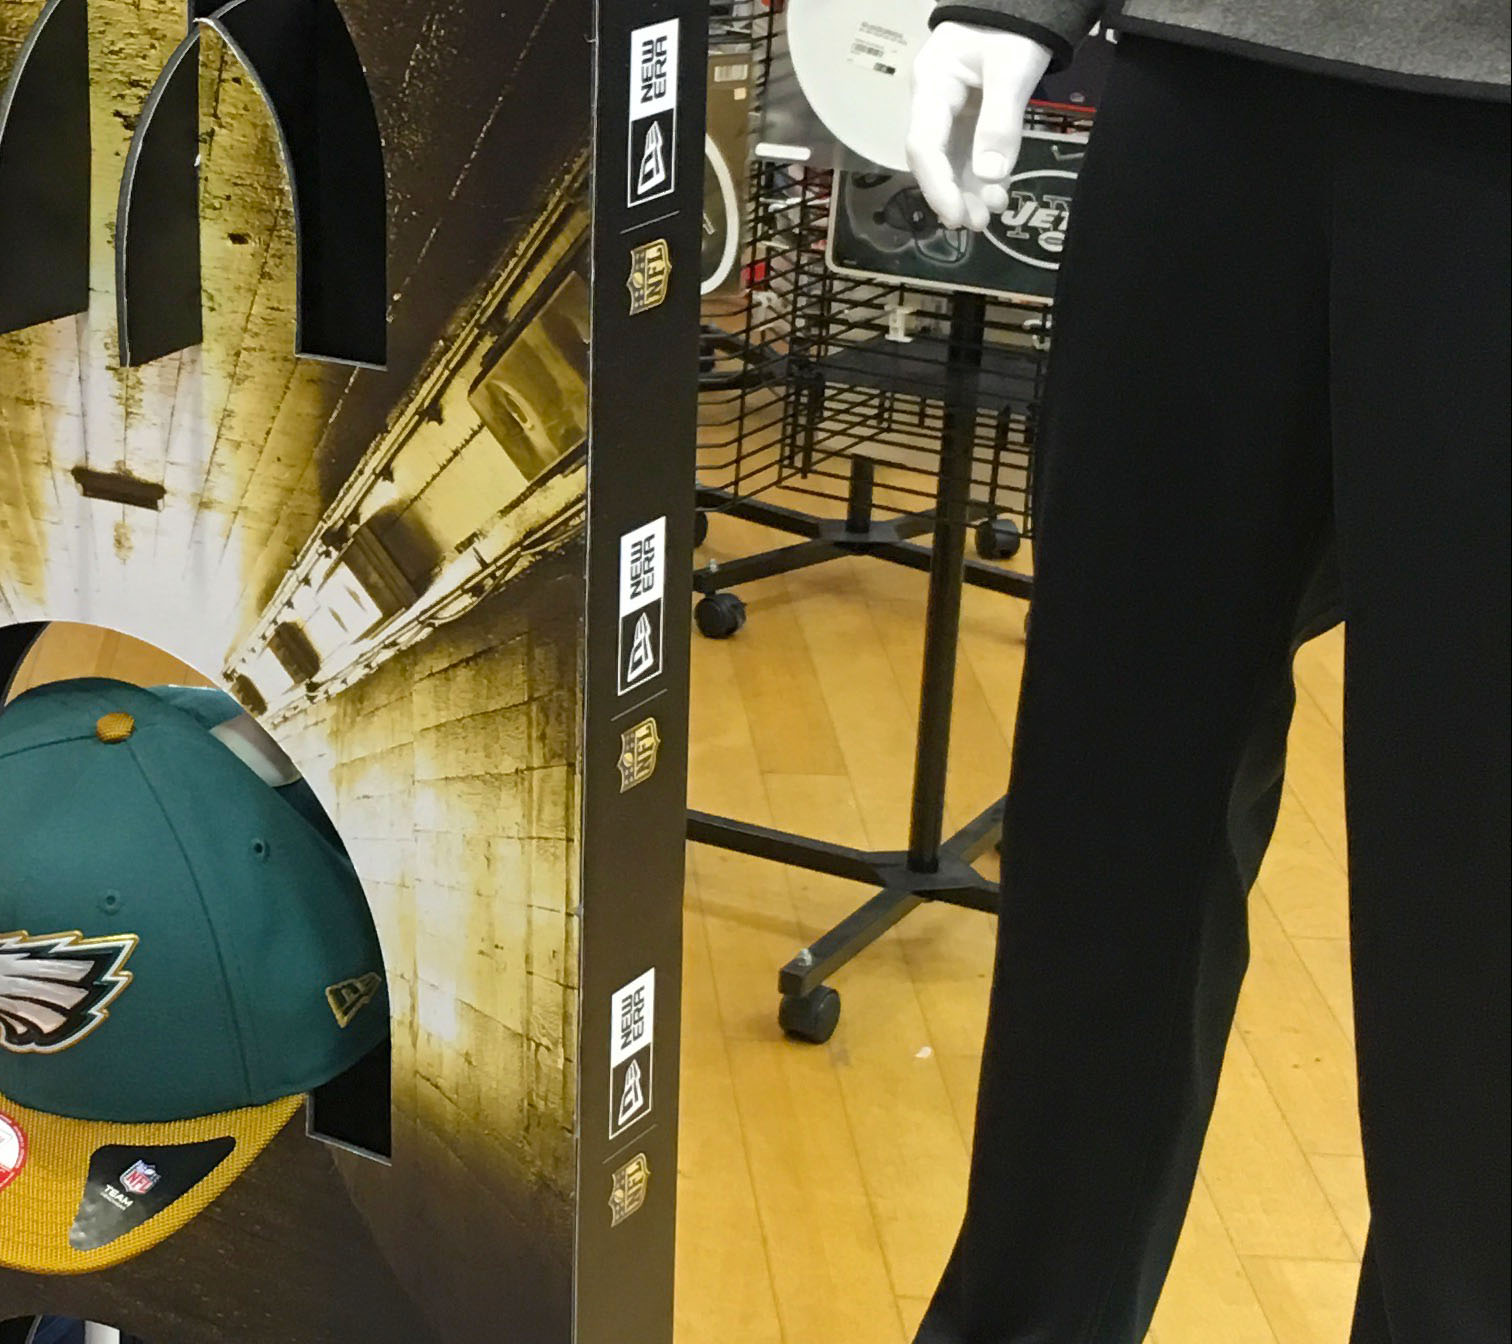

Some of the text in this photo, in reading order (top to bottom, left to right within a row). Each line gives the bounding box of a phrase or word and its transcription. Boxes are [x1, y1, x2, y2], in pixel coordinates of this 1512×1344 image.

[640, 38, 655, 104] NEW
[654, 35, 668, 100] ERA
[630, 540, 643, 600] NEW
[643, 533, 656, 593] ERA
[621, 994, 633, 1051] NEW
[632, 986, 645, 1041] ERA
[104, 1184, 134, 1208] TEAM
[125, 1170, 152, 1194] NFL
